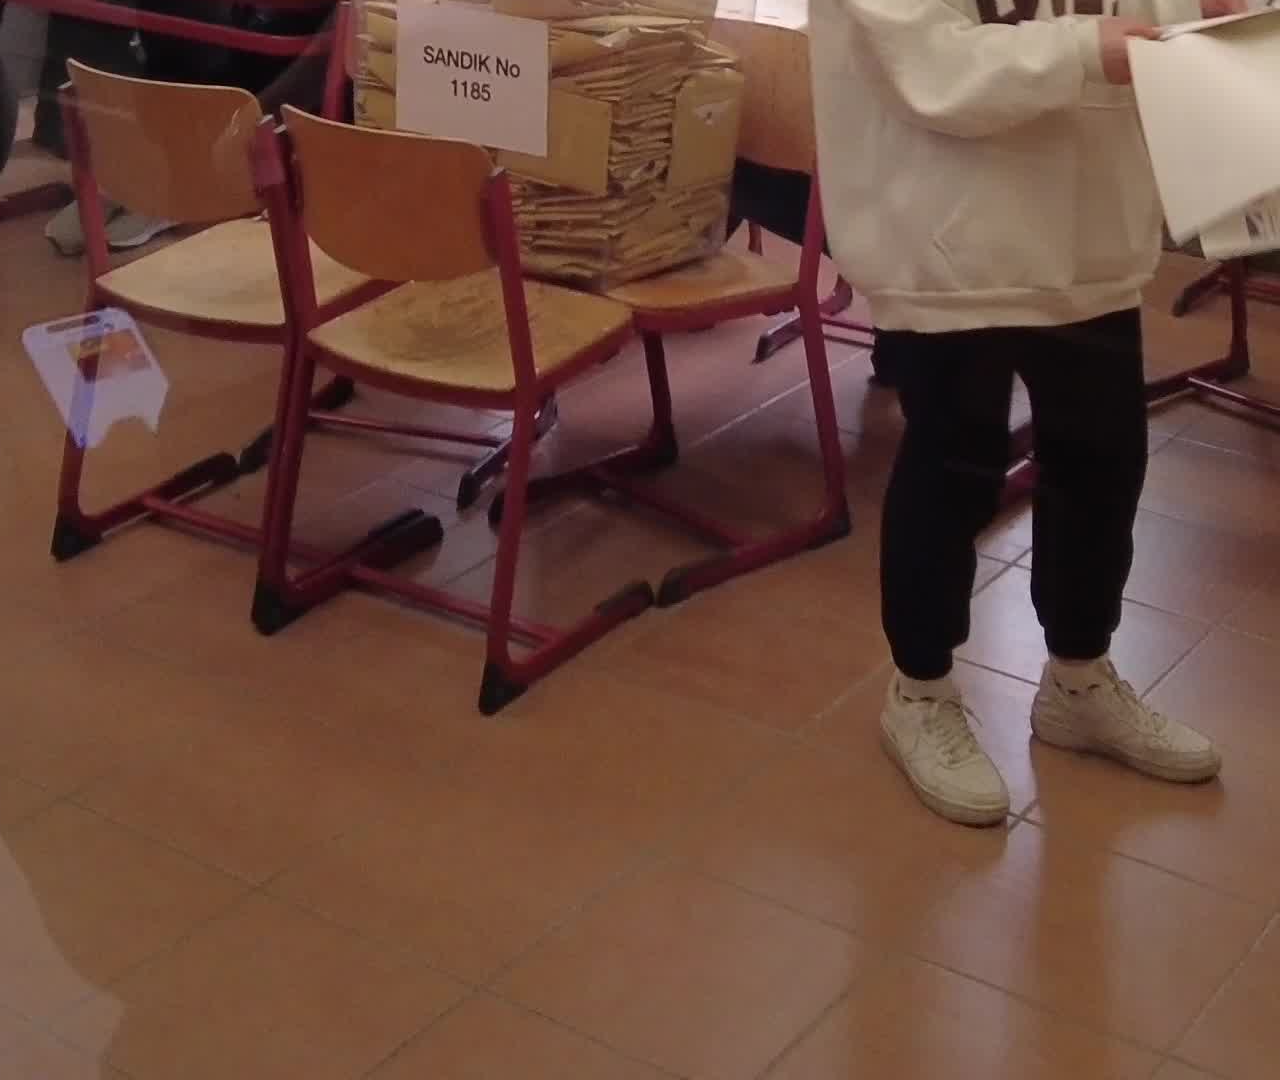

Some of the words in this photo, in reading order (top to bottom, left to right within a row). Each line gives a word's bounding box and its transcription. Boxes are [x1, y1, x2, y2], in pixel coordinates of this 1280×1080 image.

[423, 45, 491, 74] SANDIK
[496, 55, 521, 78] No
[451, 79, 491, 102] 1185
